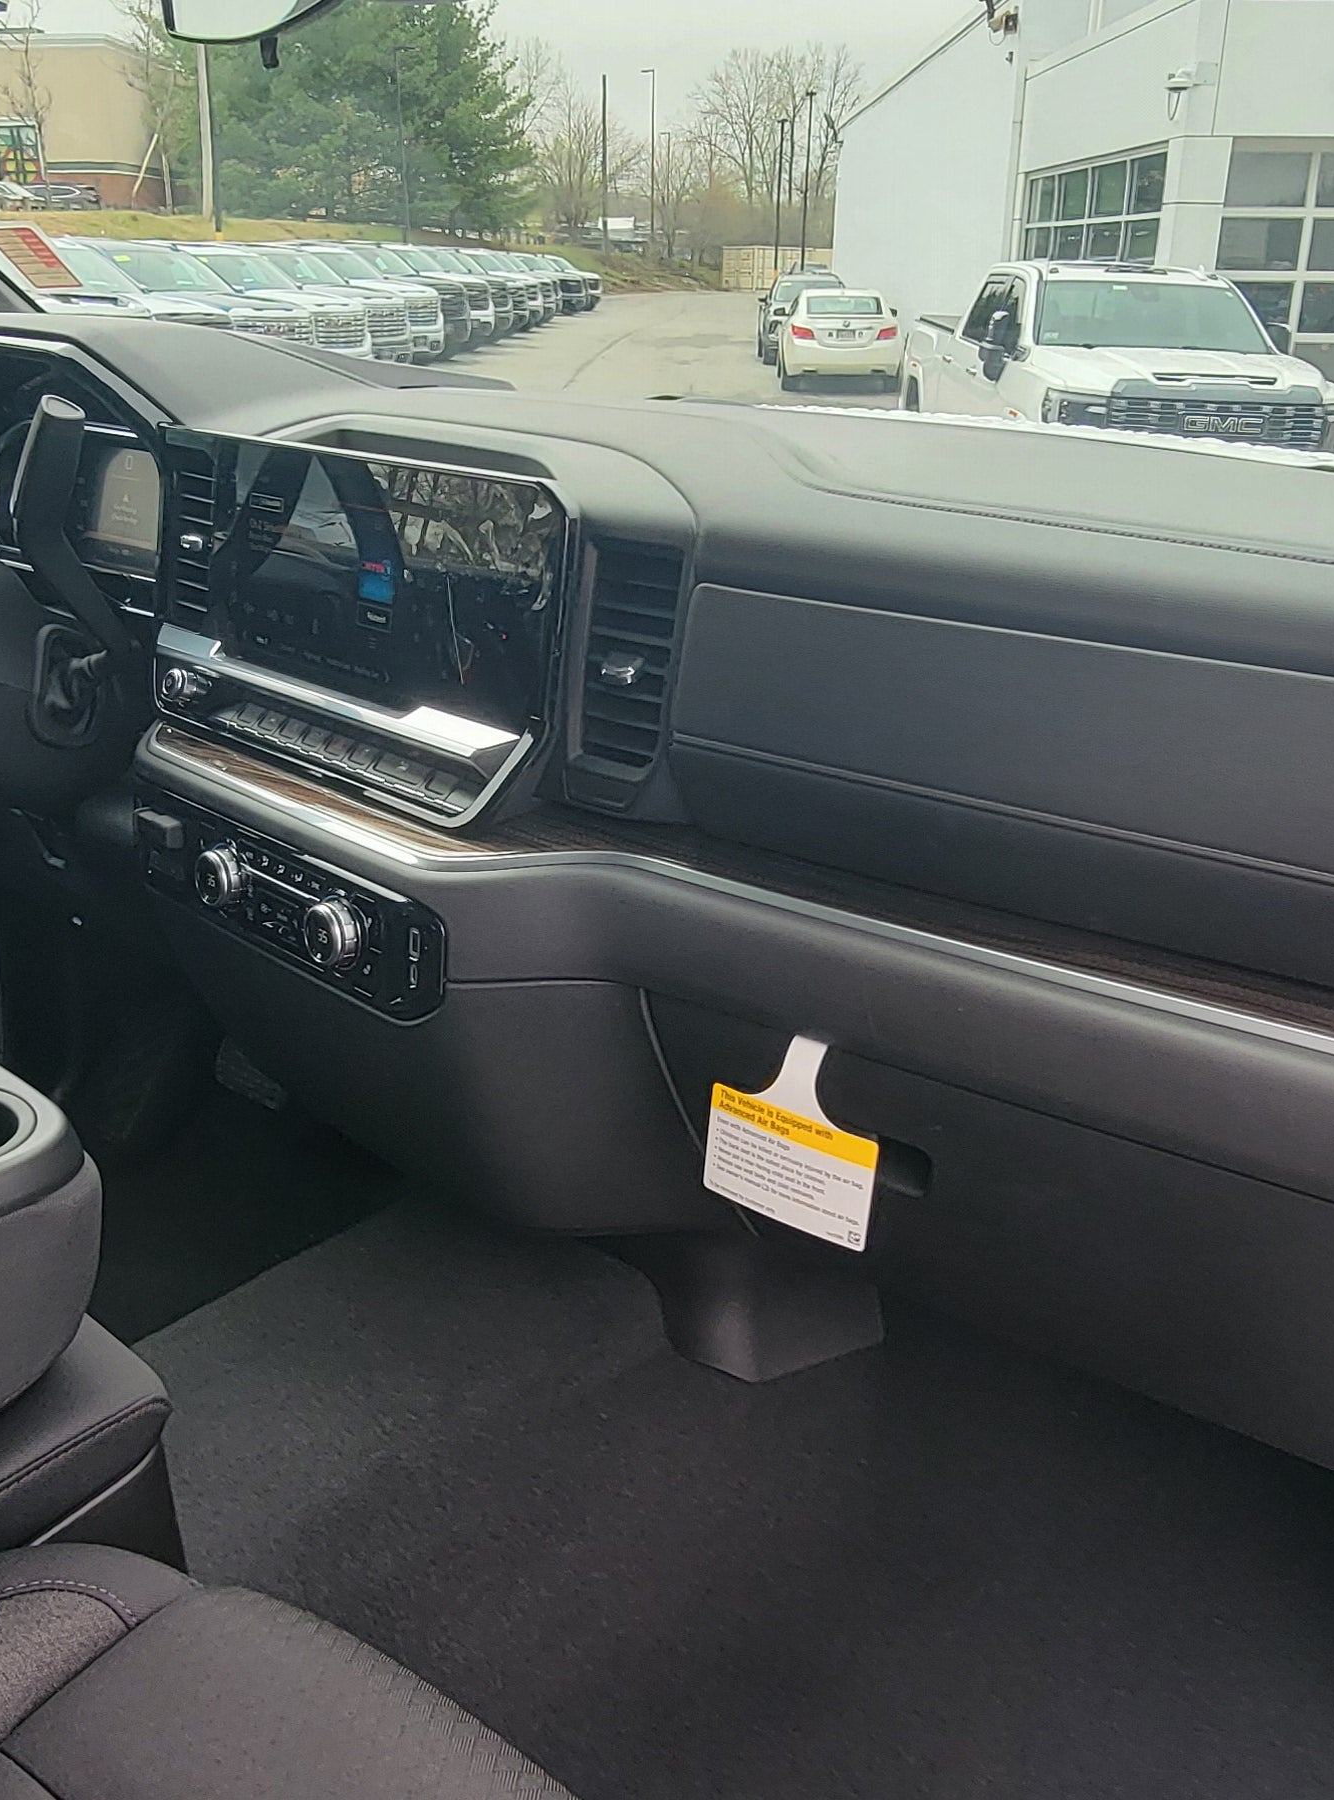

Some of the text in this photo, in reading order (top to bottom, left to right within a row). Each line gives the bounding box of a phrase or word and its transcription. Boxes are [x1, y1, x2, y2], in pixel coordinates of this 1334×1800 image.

[1183, 415, 1264, 433] GMC
[719, 1100, 790, 1136] Advanced Air Bags
[720, 1088, 736, 1103] This
[737, 1096, 765, 1115] Vehicle
[775, 1111, 813, 1134] Equipped
[815, 1128, 833, 1141] with
